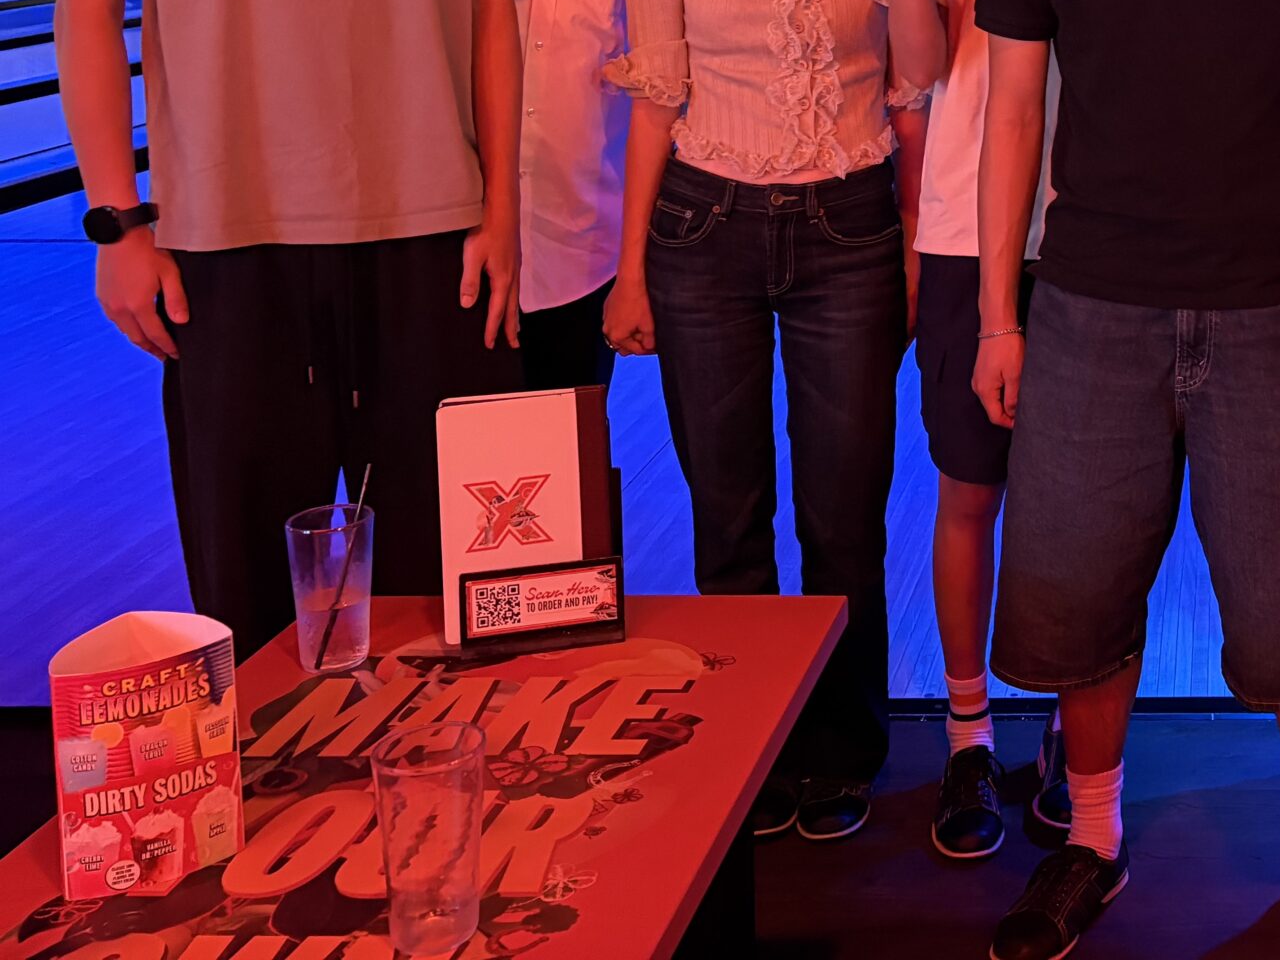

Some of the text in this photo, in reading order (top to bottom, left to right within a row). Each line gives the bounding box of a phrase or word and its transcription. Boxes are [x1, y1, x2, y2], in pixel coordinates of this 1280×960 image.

[525, 581, 601, 601] Scan Here
[526, 596, 599, 613] TO ORDER AND PAY!
[79, 672, 211, 726] LEMONADES
[102, 662, 189, 697] CRAFT
[241, 676, 697, 758] MAKE
[85, 762, 217, 818] DIRTY SODAS
